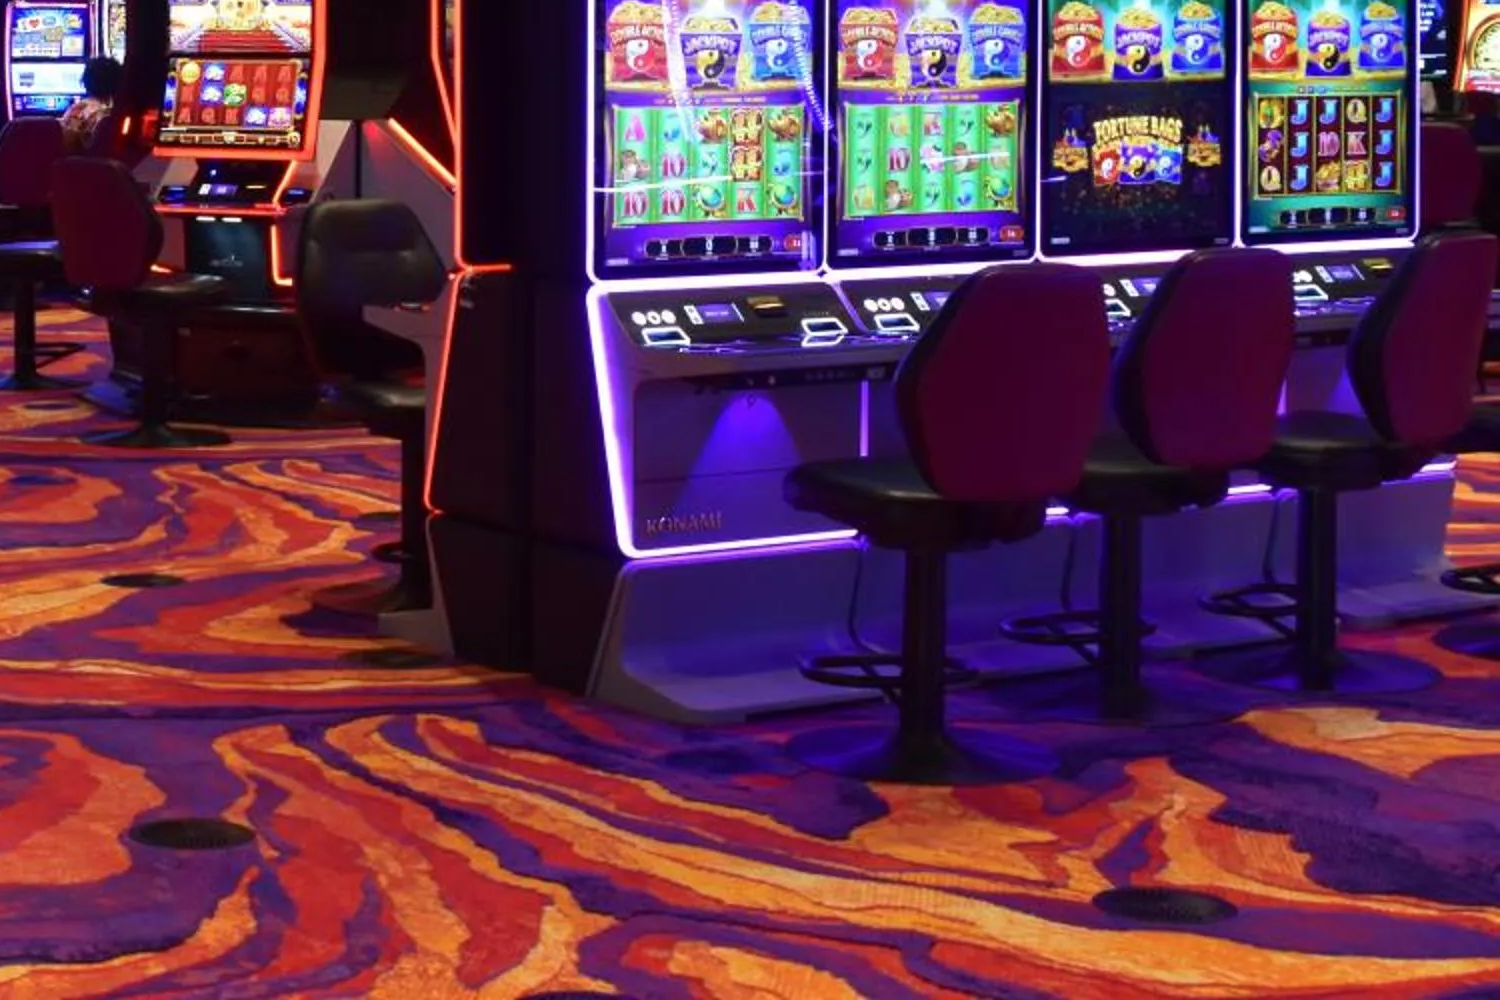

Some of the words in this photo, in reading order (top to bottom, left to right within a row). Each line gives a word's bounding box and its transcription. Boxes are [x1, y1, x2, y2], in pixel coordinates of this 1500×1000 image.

[684, 37, 738, 54] JACKPOT
[909, 37, 958, 54] JACKPOT
[1117, 32, 1161, 48] JACKPOT
[1290, 99, 1309, 125] J
[1319, 99, 1338, 125] J
[1346, 98, 1368, 124] Q
[1375, 98, 1393, 123] J
[1093, 116, 1149, 146] FORTUNE
[1150, 116, 1183, 143] BAGS
[1290, 131, 1309, 157] J
[1317, 131, 1340, 157] 10
[1346, 131, 1367, 155] K
[1375, 130, 1393, 155] J
[1260, 165, 1282, 191] Q
[1290, 164, 1309, 190] J
[1375, 161, 1393, 187] J
[646, 511, 722, 533] KONAMI
